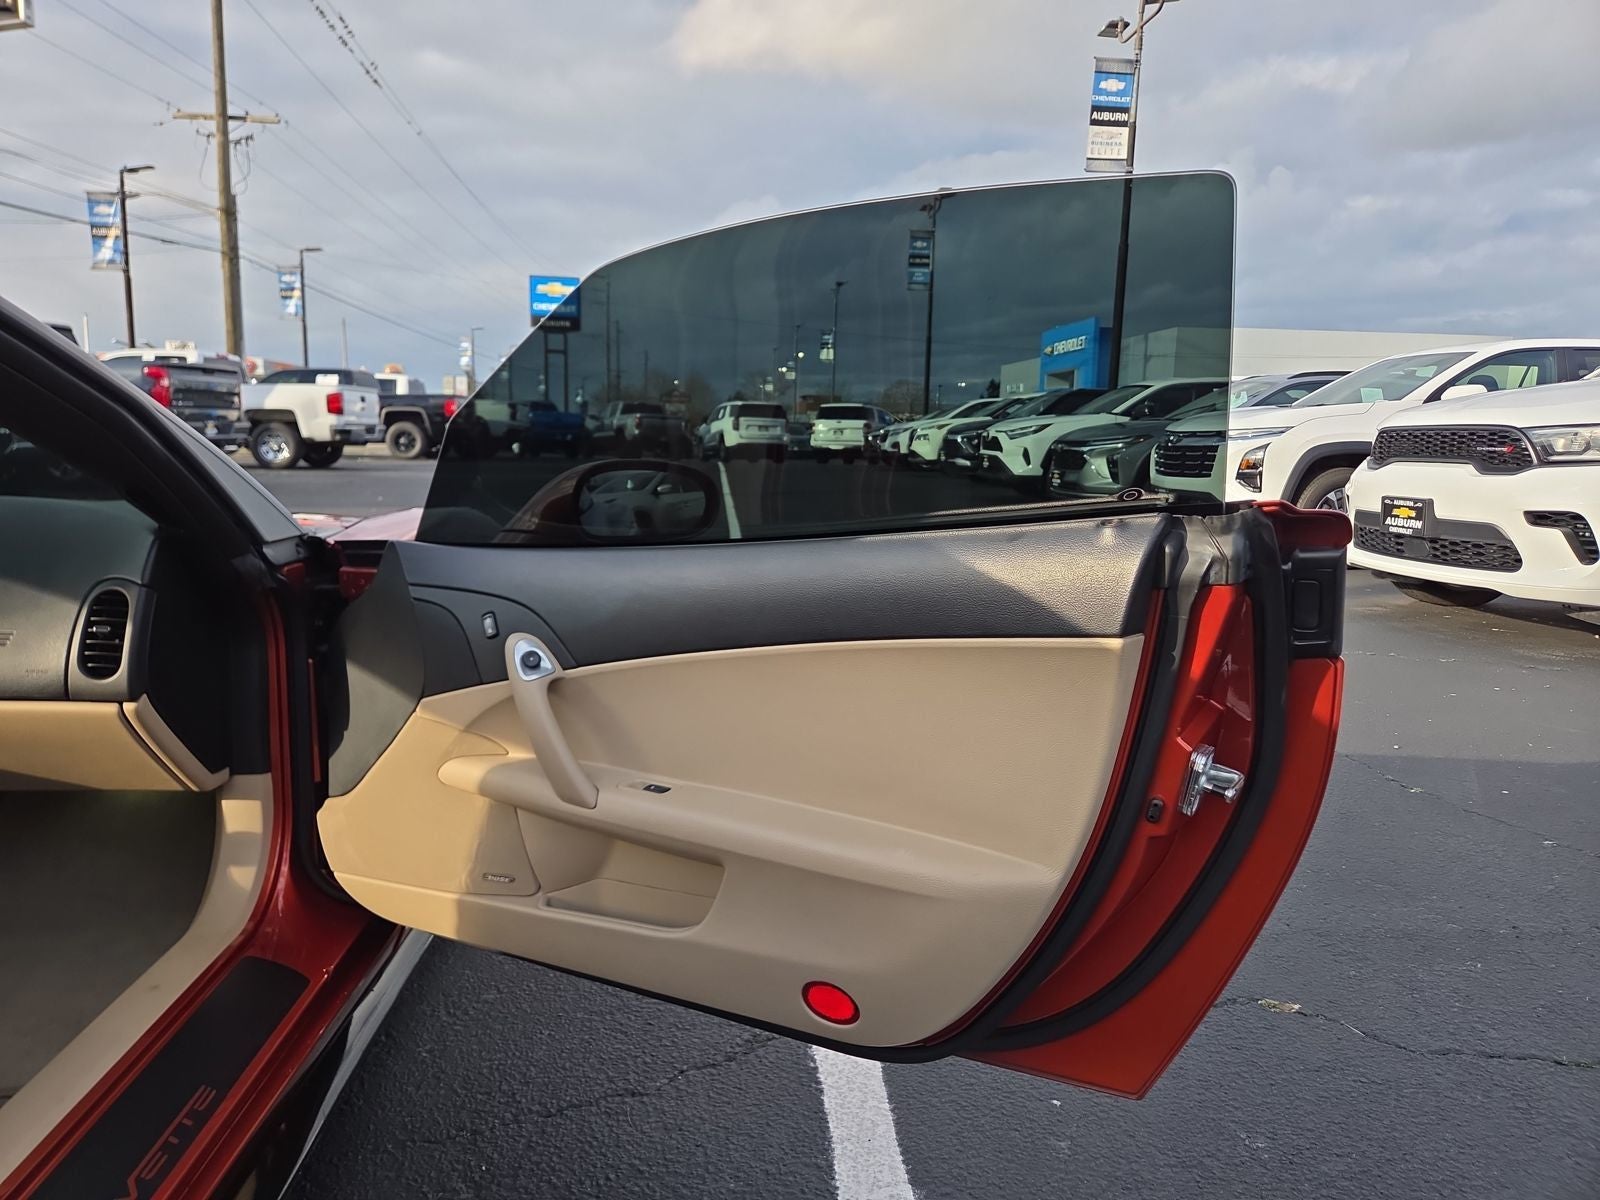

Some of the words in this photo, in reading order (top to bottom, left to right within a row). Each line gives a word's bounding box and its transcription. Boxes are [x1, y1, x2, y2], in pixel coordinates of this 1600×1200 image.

[1091, 111, 1129, 121] AUBURN
[1090, 148, 1122, 156] ELITE
[1053, 335, 1087, 355] CHEVROLET
[1384, 516, 1423, 529] AUBURN
